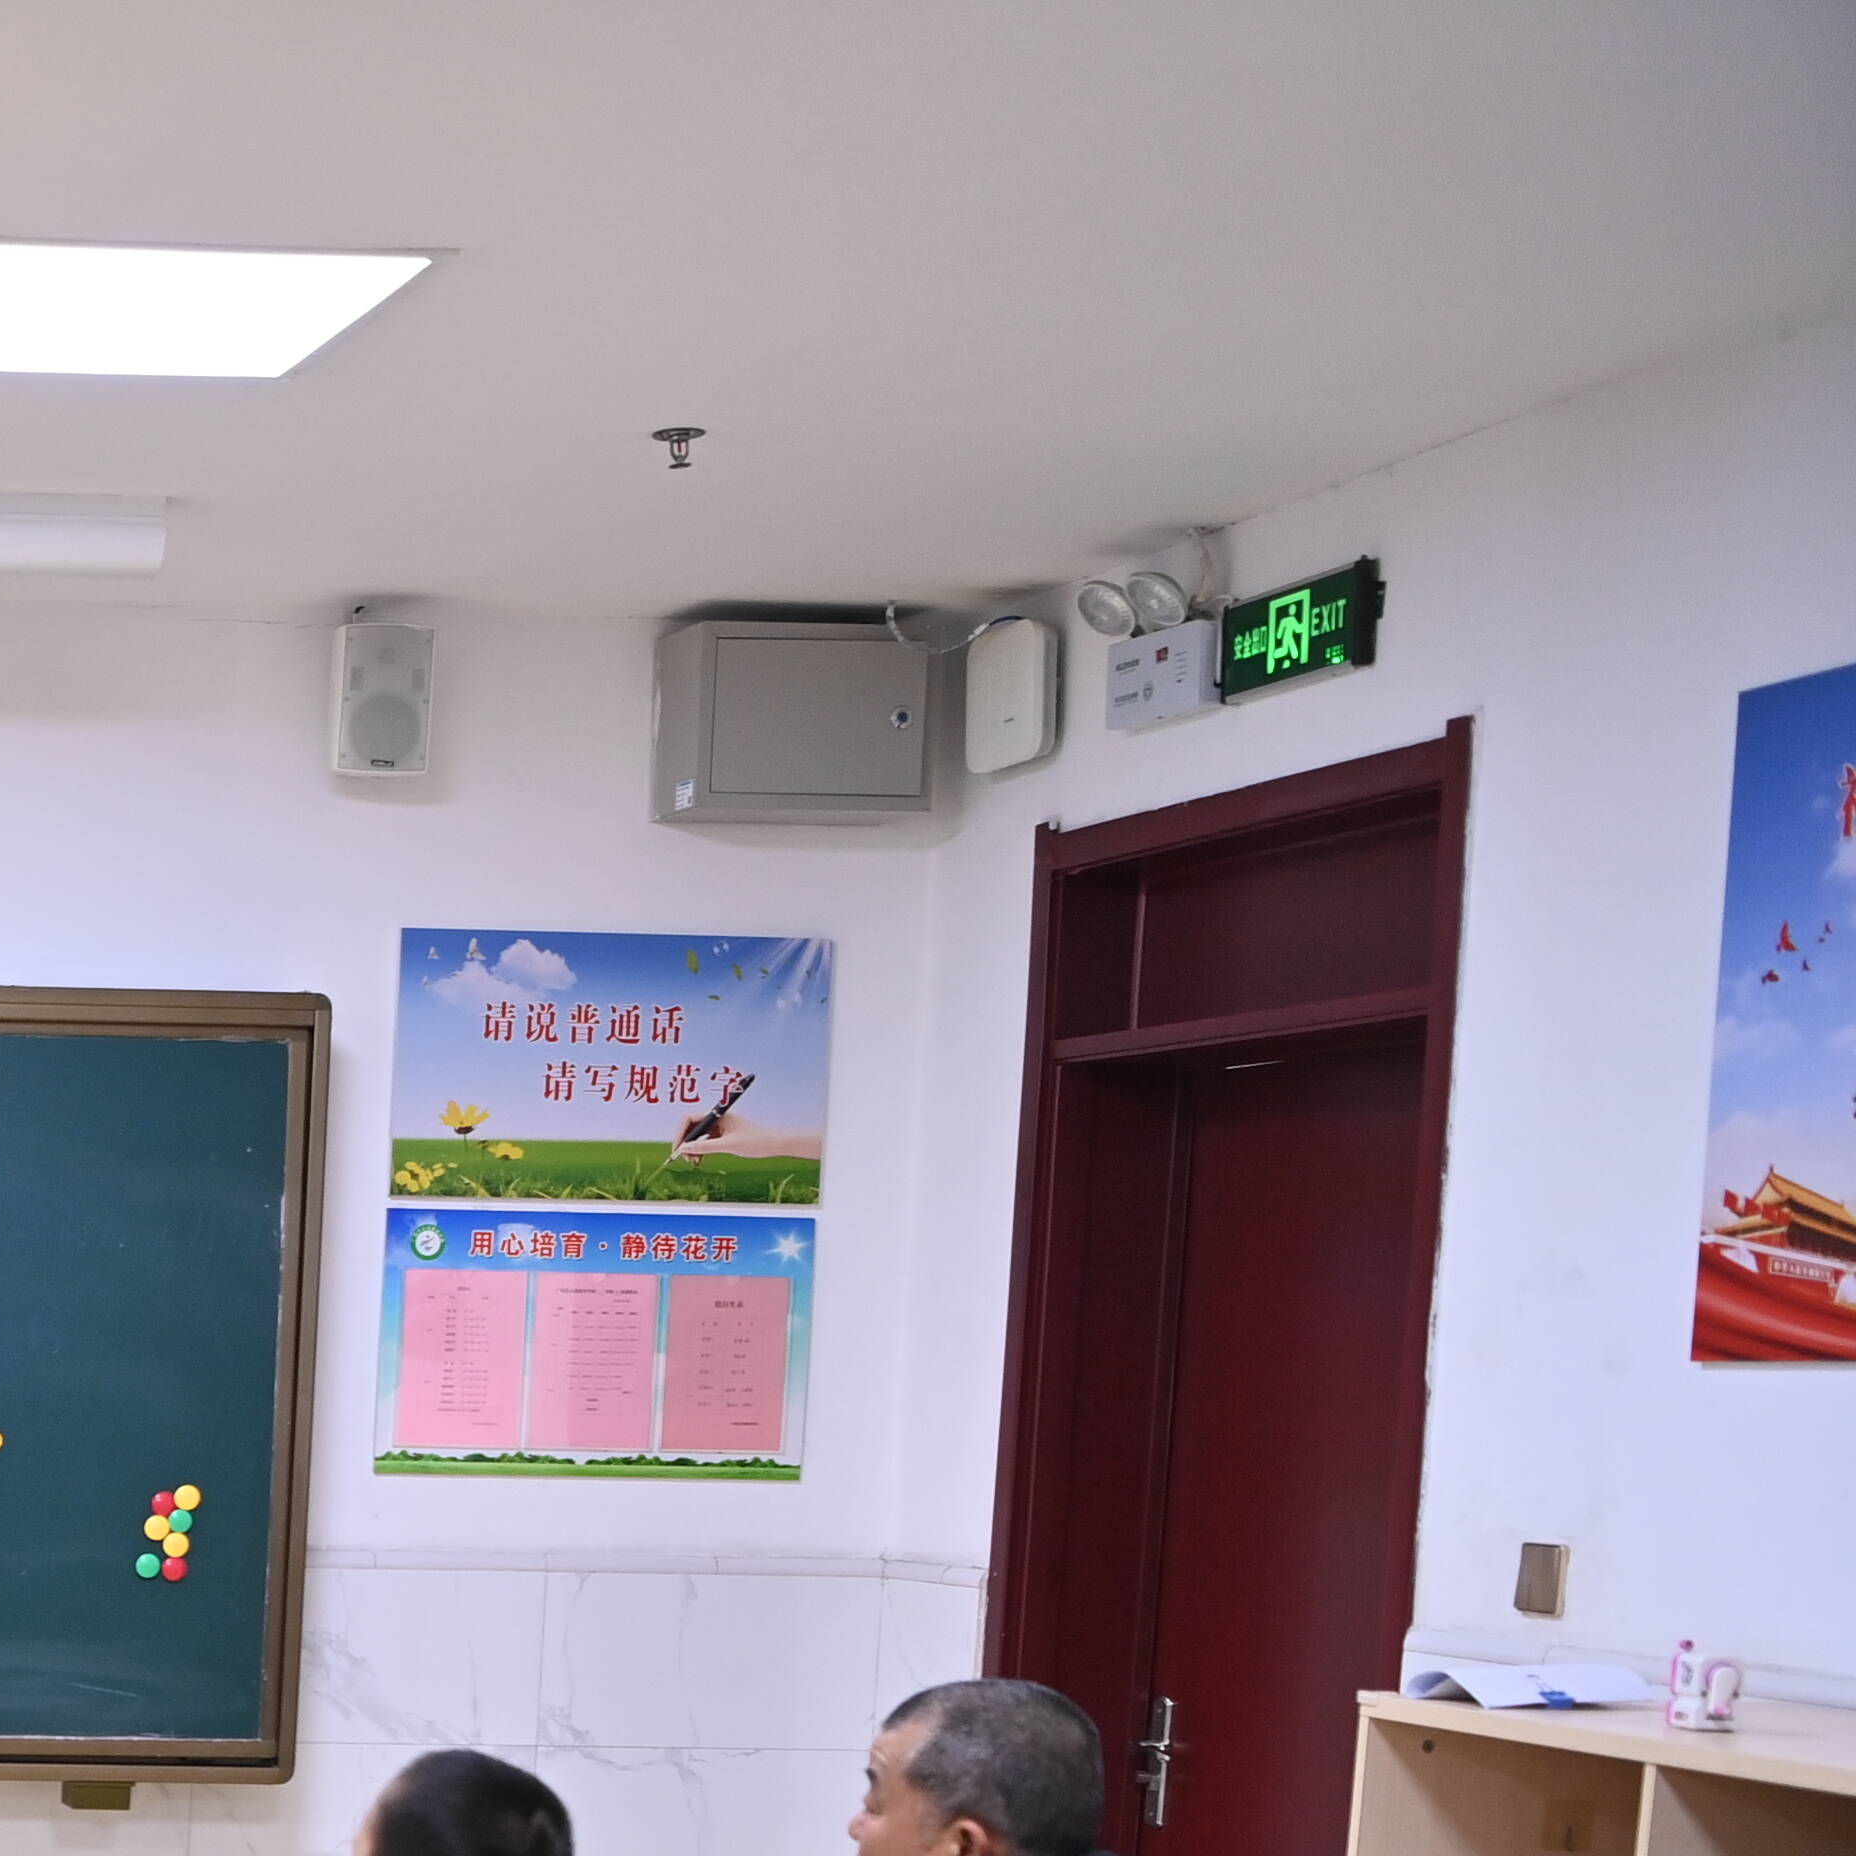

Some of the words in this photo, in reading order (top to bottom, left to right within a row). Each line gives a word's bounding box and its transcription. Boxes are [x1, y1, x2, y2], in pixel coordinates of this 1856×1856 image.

[1311, 598, 1347, 637] EXIT
[480, 1001, 686, 1045] 请说普通话
[541, 1060, 744, 1106] 请写规范字
[468, 1229, 740, 1263] 用心培育·静待花开
